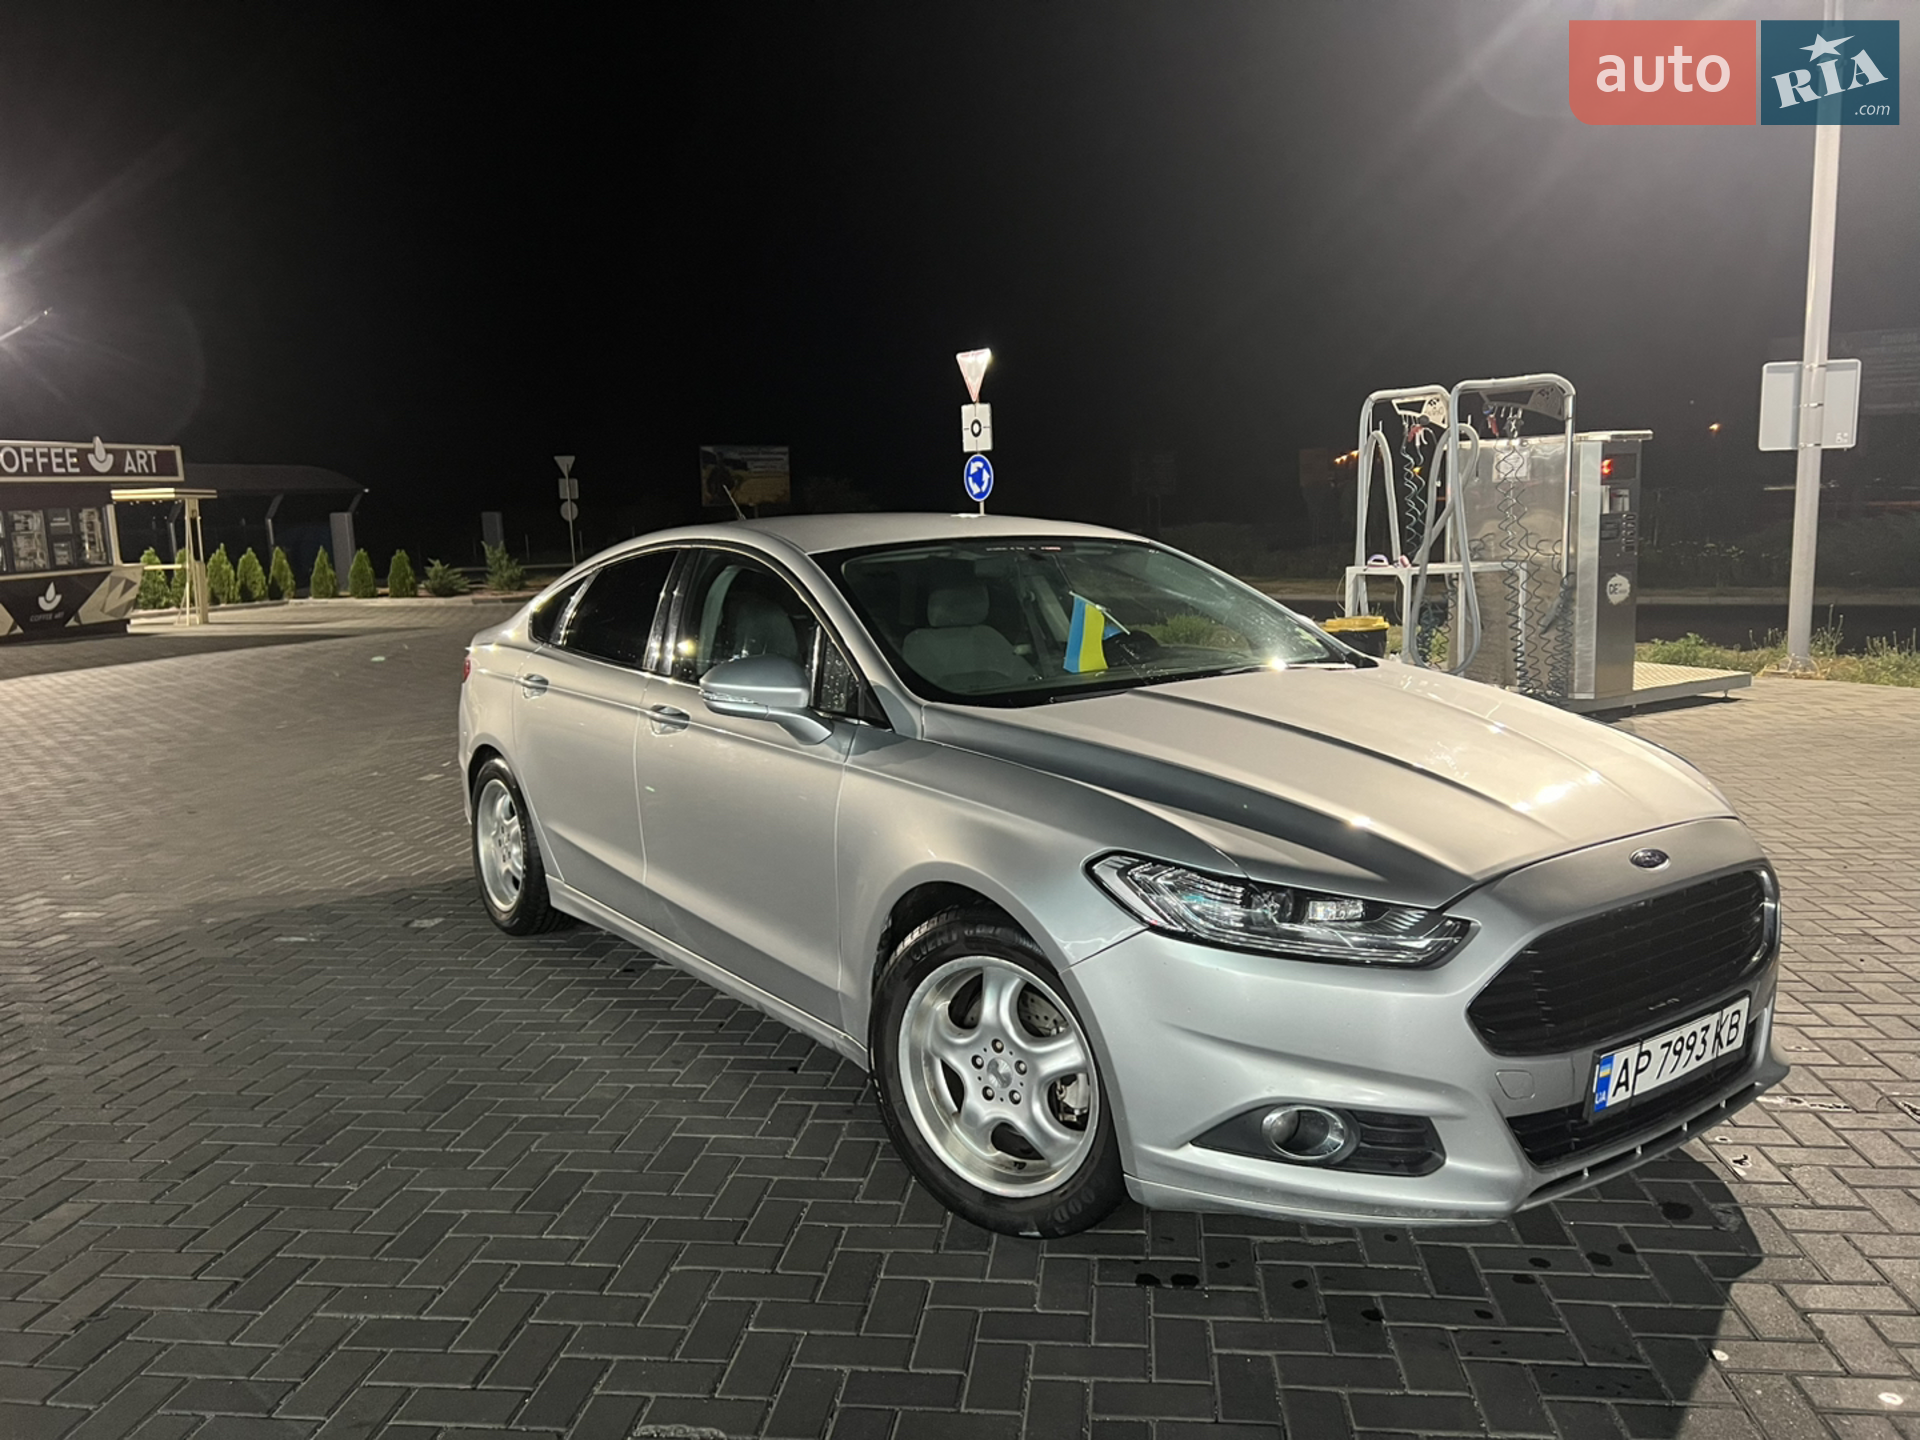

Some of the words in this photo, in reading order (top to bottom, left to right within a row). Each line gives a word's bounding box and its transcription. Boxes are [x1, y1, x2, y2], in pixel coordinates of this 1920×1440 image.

[124, 450, 157, 473] ART
[1612, 1050, 1652, 1098] AP
[1656, 1024, 1711, 1080] 7993
[1712, 1009, 1742, 1055] KB
